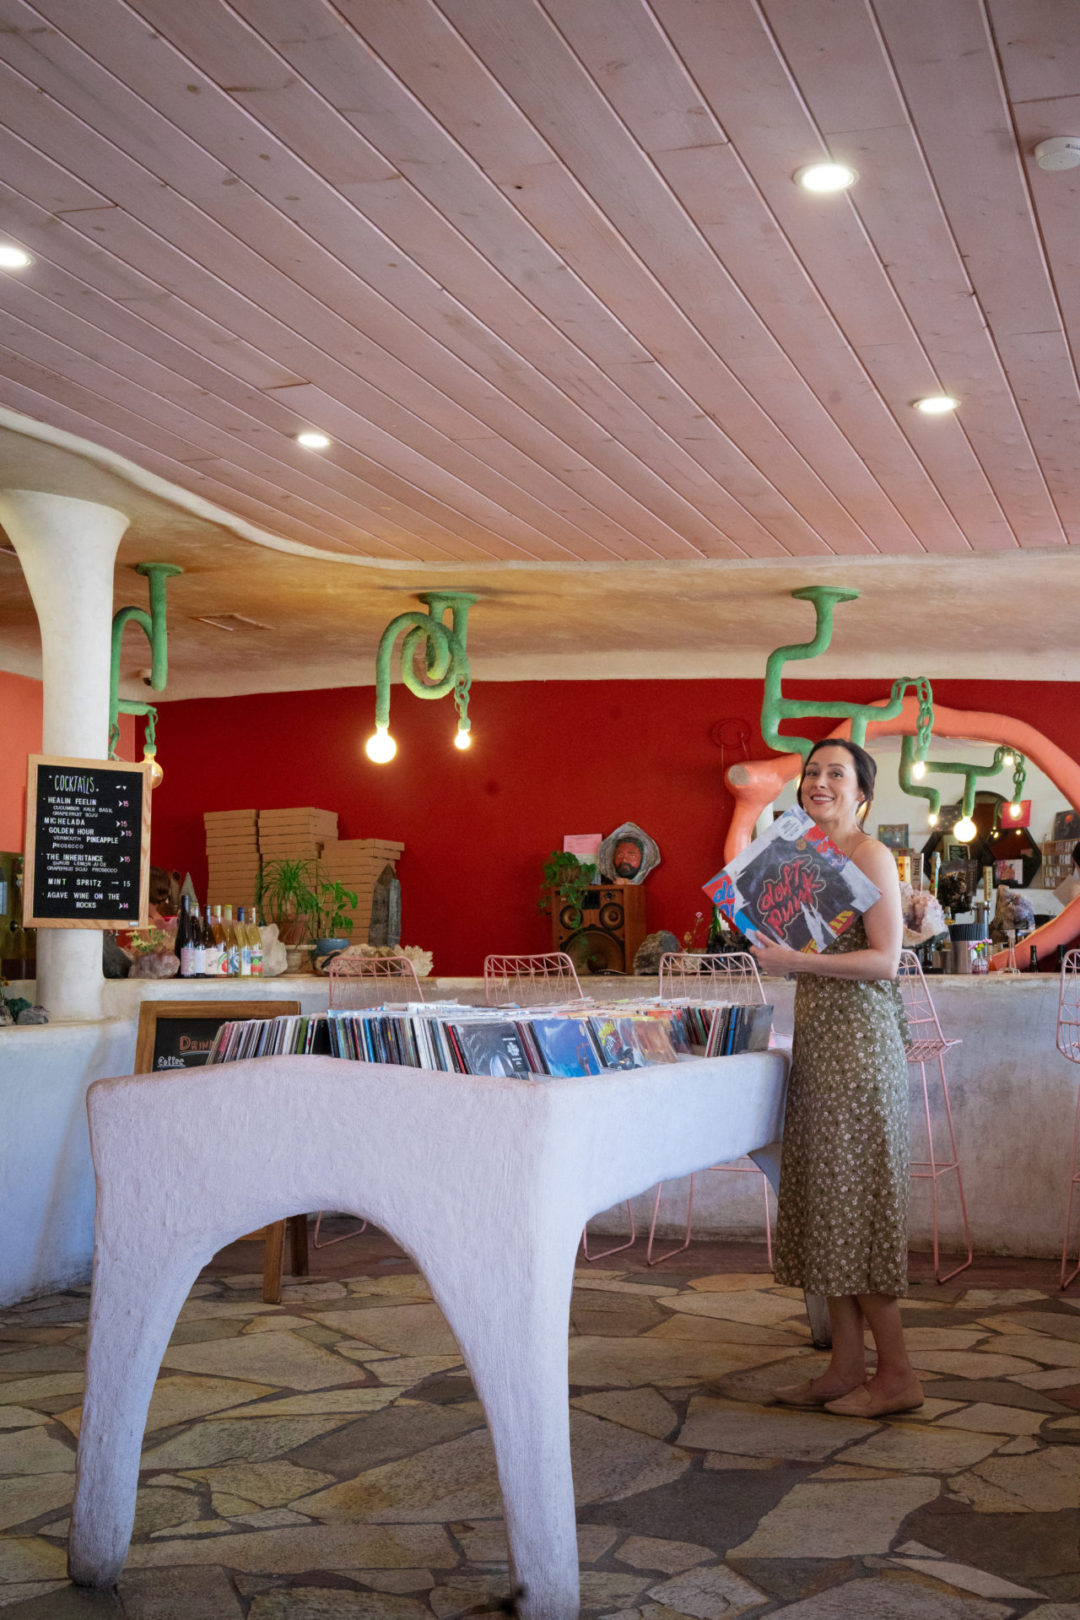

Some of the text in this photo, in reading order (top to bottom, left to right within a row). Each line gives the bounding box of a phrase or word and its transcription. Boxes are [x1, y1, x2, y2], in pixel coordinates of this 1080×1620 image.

[48, 796, 71, 804] HEALIN
[86, 836, 119, 844] PINEAPPLE
[76, 879, 101, 887] SPRITZ
[47, 891, 68, 899] AGAVE
